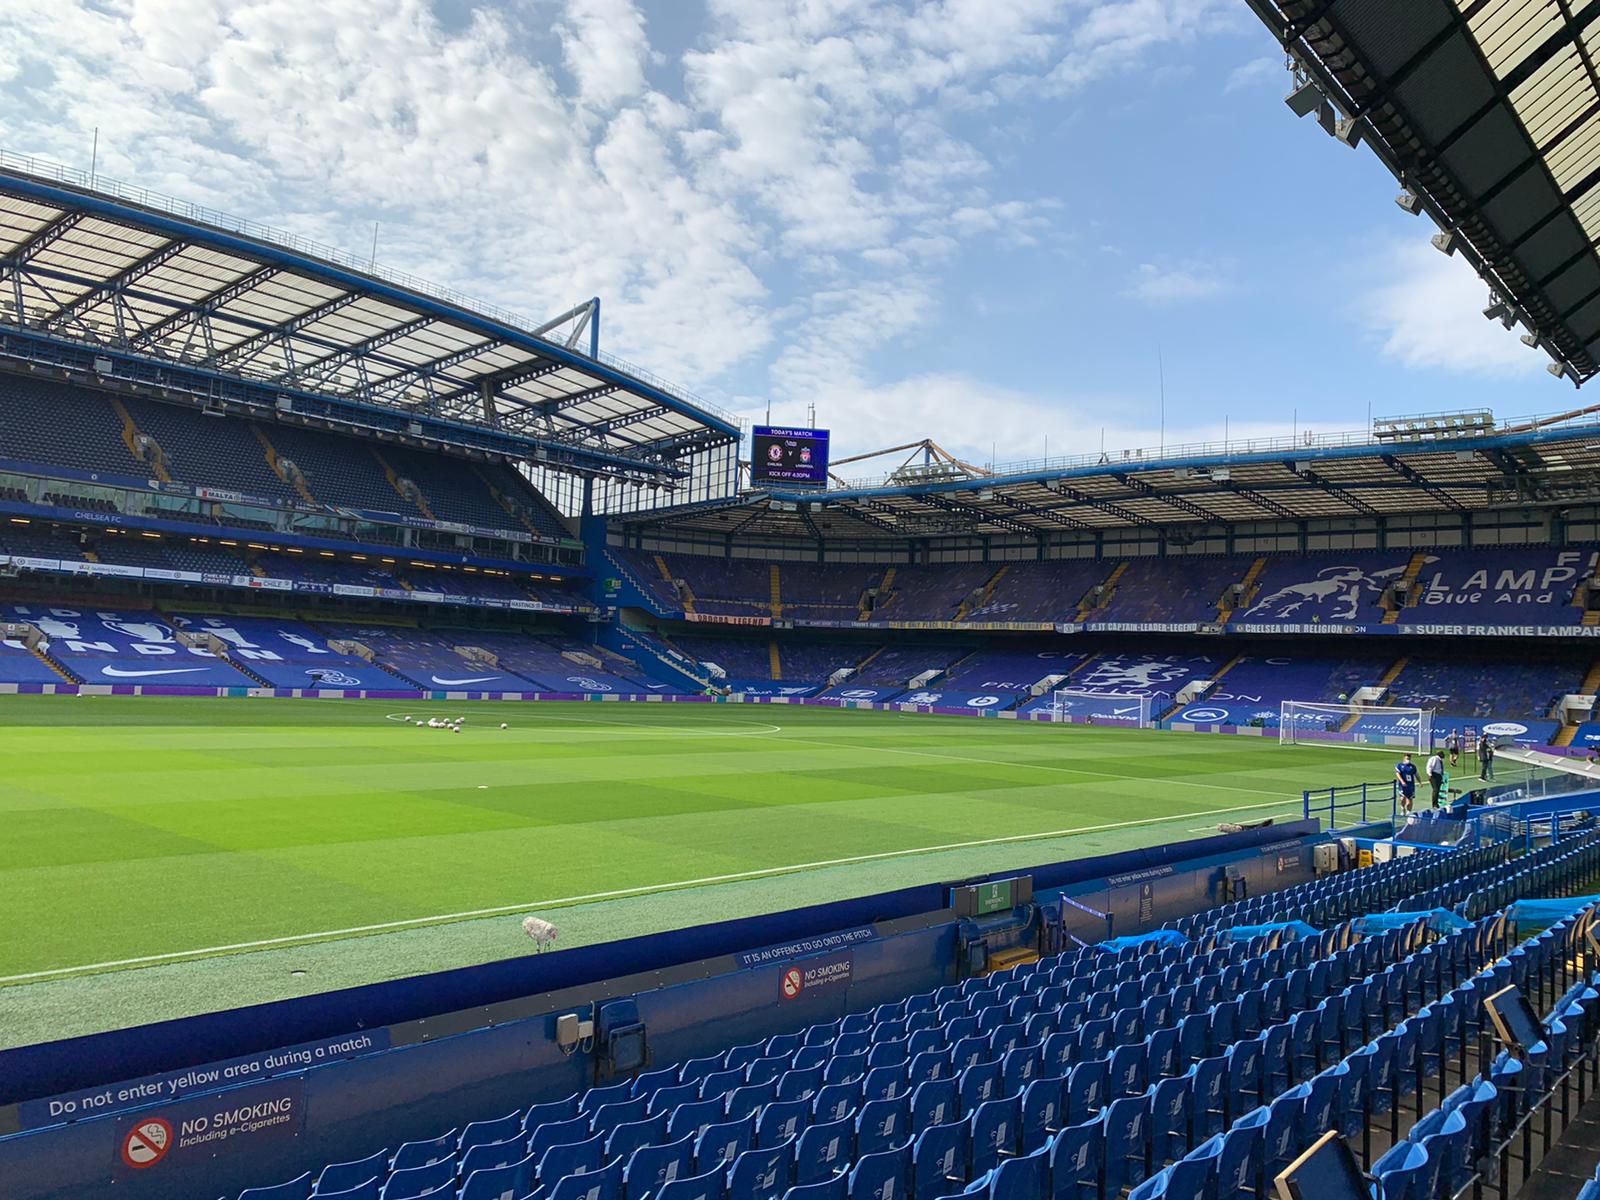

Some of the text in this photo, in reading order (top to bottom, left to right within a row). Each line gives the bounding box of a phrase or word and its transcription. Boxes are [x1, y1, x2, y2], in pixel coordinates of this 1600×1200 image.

[208, 491, 234, 500] MALTA
[74, 511, 122, 524] CHELSEA FC
[1424, 591, 1553, 605] Blue And
[511, 601, 535, 609] HASTINGS
[733, 616, 764, 625] LEGEND
[1245, 624, 1343, 633] CHELSEA OUR RELIGION
[1416, 625, 1464, 635] SUPER
[1466, 625, 1534, 636] FRANKIE
[1361, 724, 1446, 734] MILLENNUM
[743, 929, 873, 964] IT IS AN OFFENCE TO GO ONTO THE PITCH
[804, 961, 850, 981] NO SMOKING
[804, 979, 825, 989] Including
[49, 1034, 372, 1117] Do not enter yellow area during a match
[181, 1096, 292, 1137] NO SMOKING
[179, 1113, 291, 1149] Including e-Cigarettes
